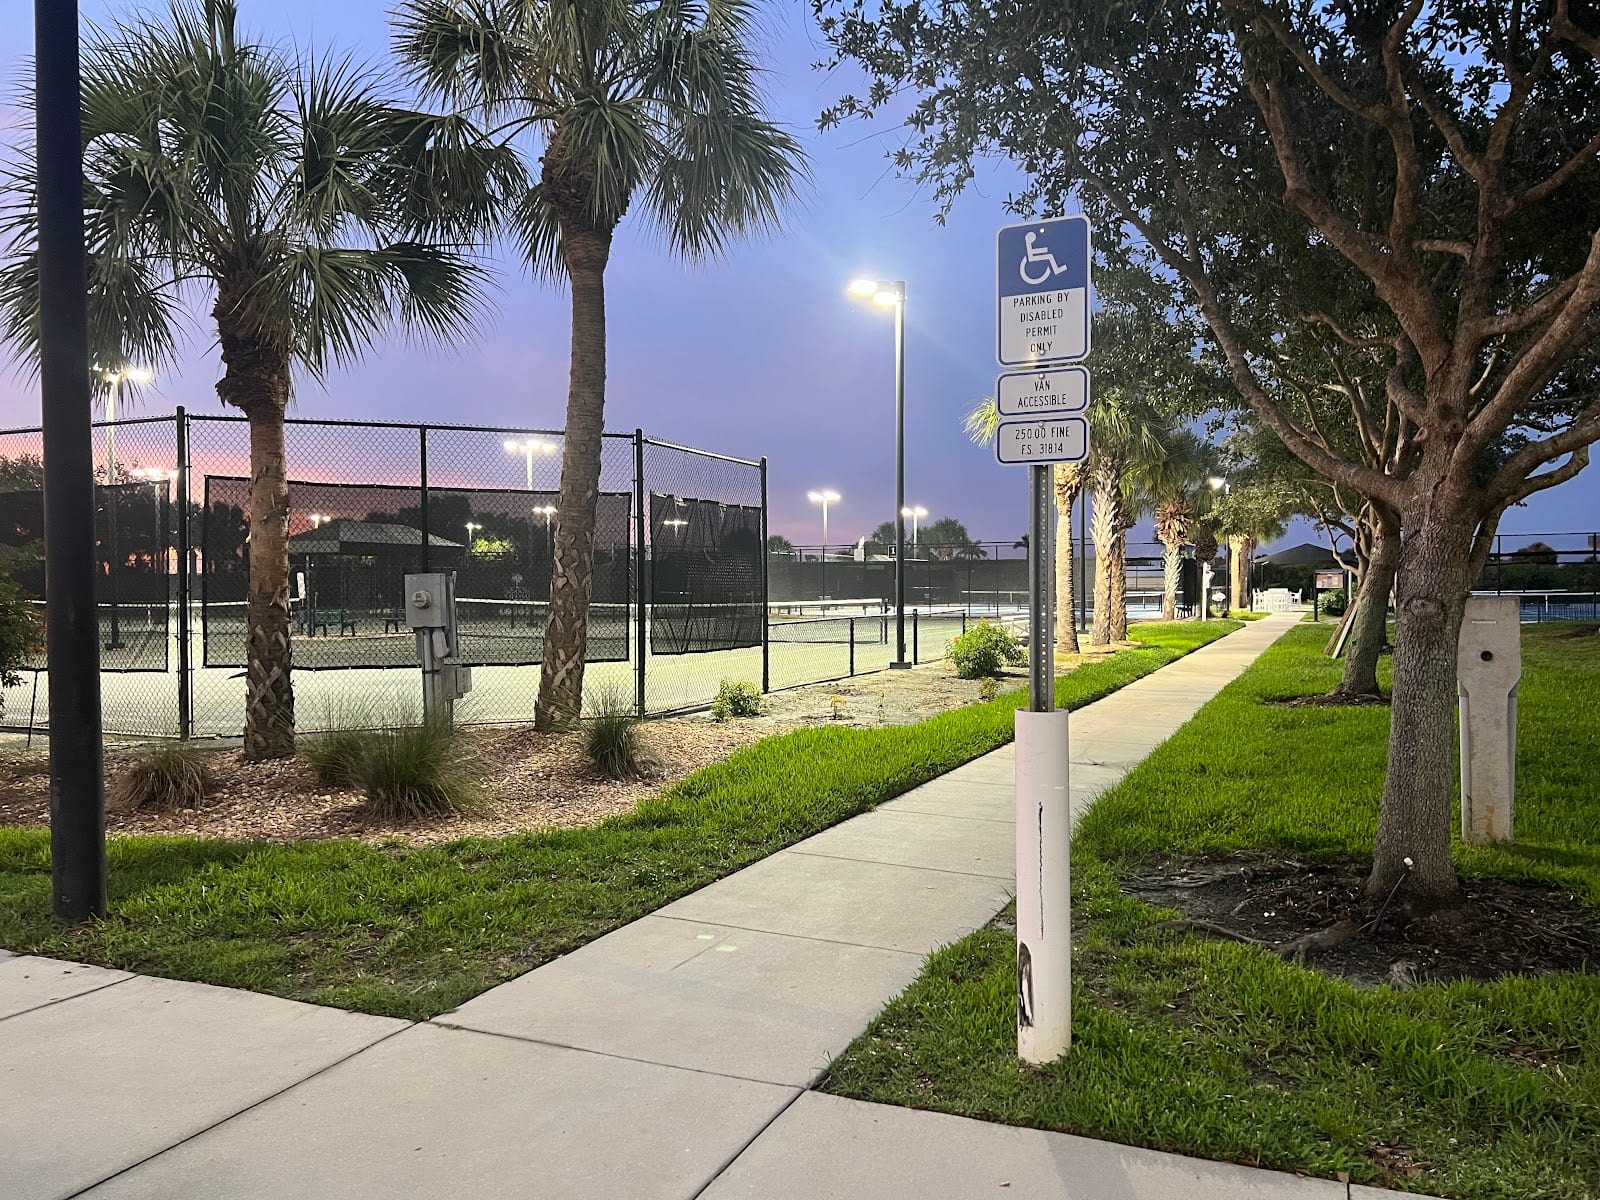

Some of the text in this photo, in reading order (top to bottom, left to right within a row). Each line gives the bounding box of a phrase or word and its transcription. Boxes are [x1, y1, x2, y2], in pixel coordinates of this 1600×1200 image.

[1013, 291, 1070, 308] PARKING BY
[1020, 308, 1063, 323] DISABLED
[1025, 325, 1057, 338] PERMIT
[1030, 341, 1053, 352] ONLY
[1034, 380, 1050, 392] VAN
[1017, 394, 1067, 408] ACCESSIBLE
[1051, 426, 1070, 438] FINE
